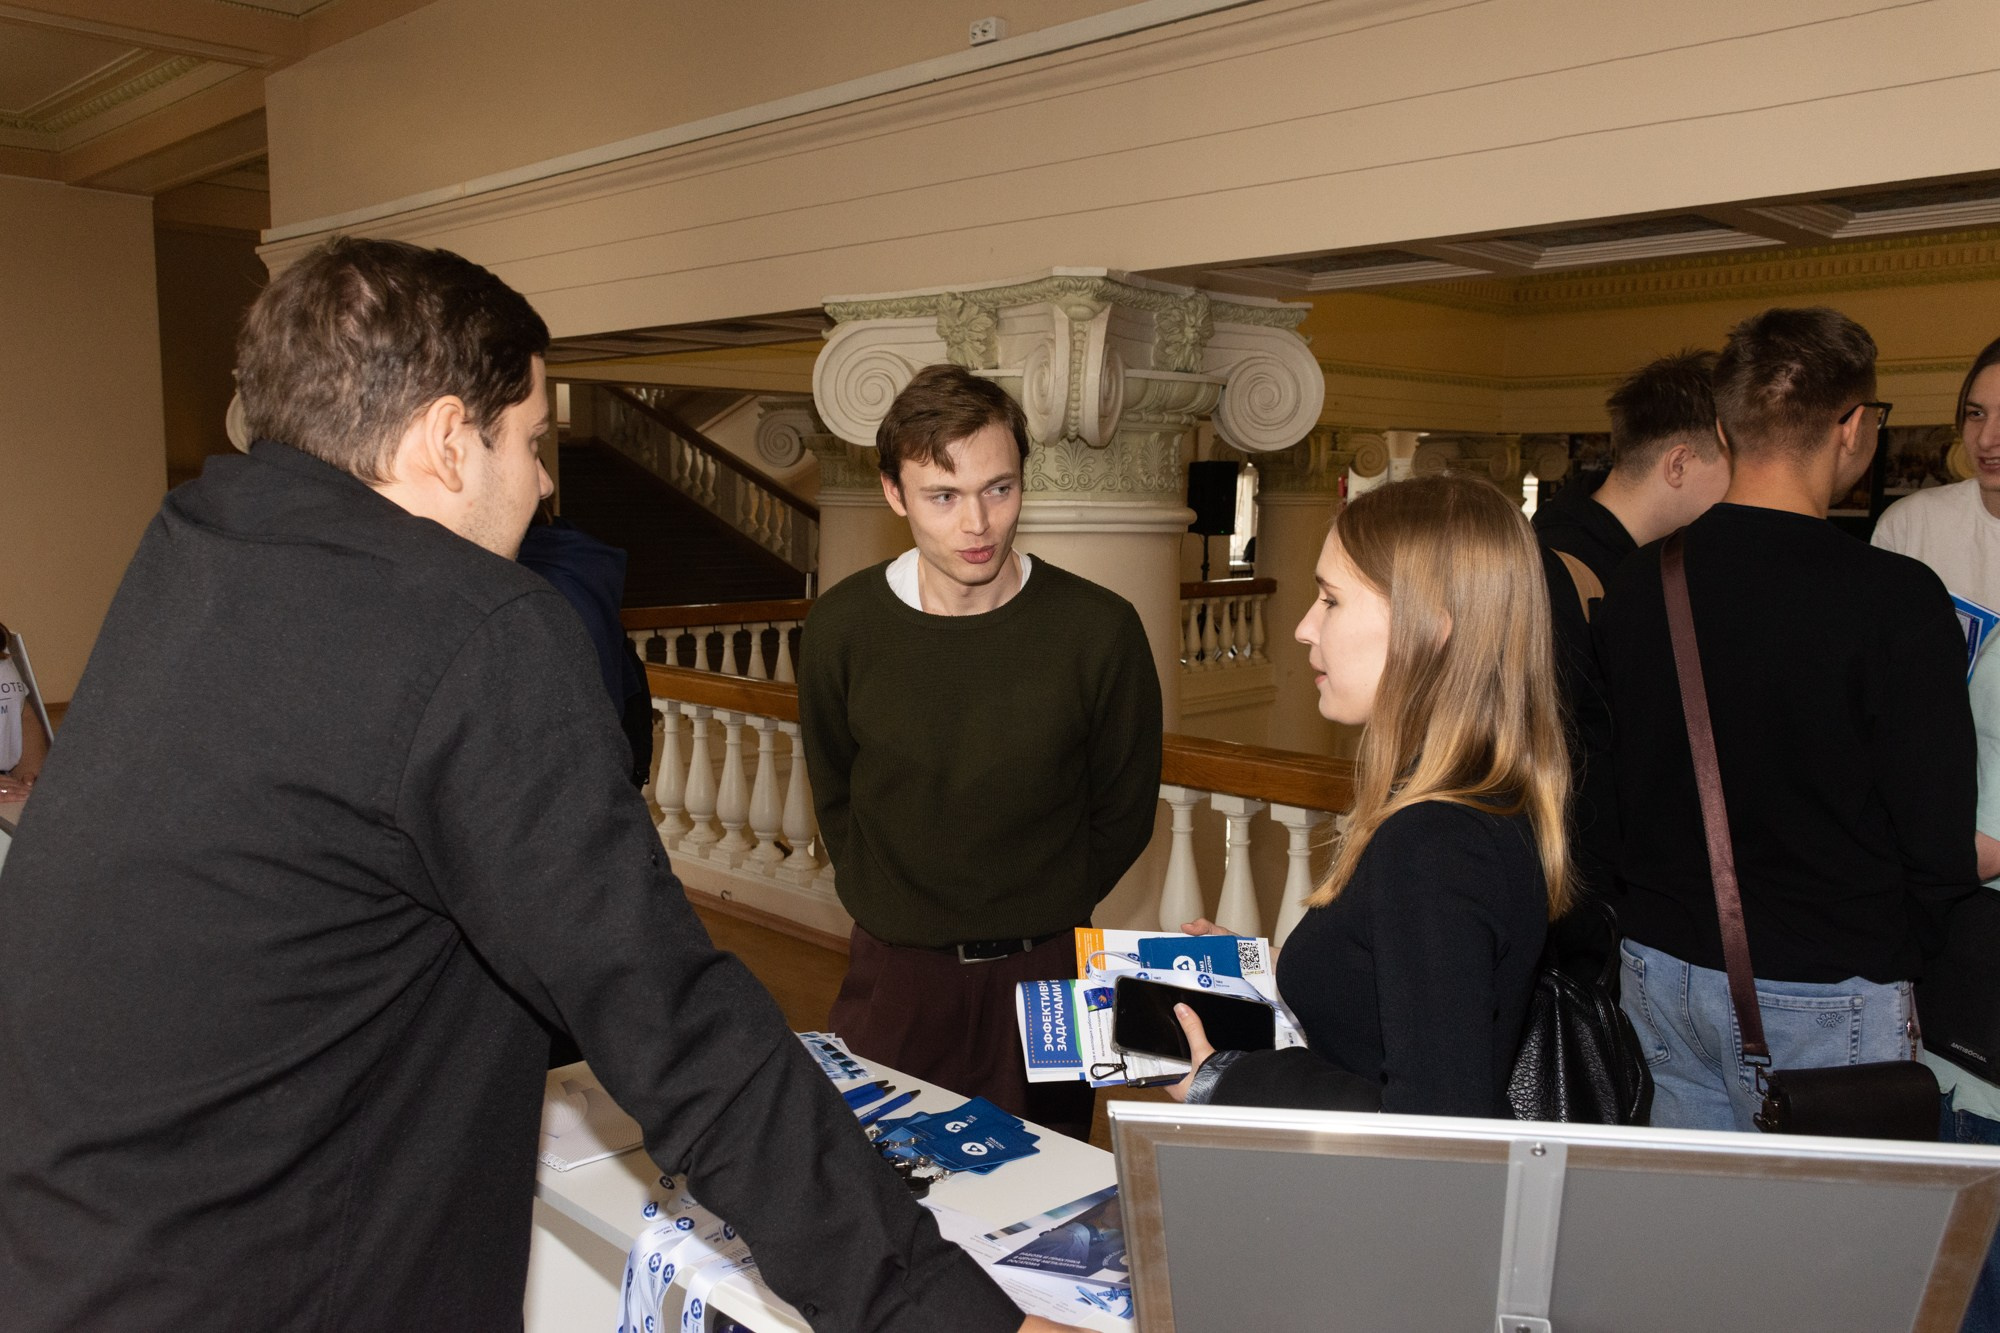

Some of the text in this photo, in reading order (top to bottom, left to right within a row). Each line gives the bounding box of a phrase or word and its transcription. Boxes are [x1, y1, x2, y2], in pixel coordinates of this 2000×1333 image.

[1037, 980, 1054, 1052] ЭФФЕКТИВН
[1051, 984, 1067, 1052] ЗАДАЧАМИ
[1950, 1042, 1987, 1063] ANTISOCIAL
